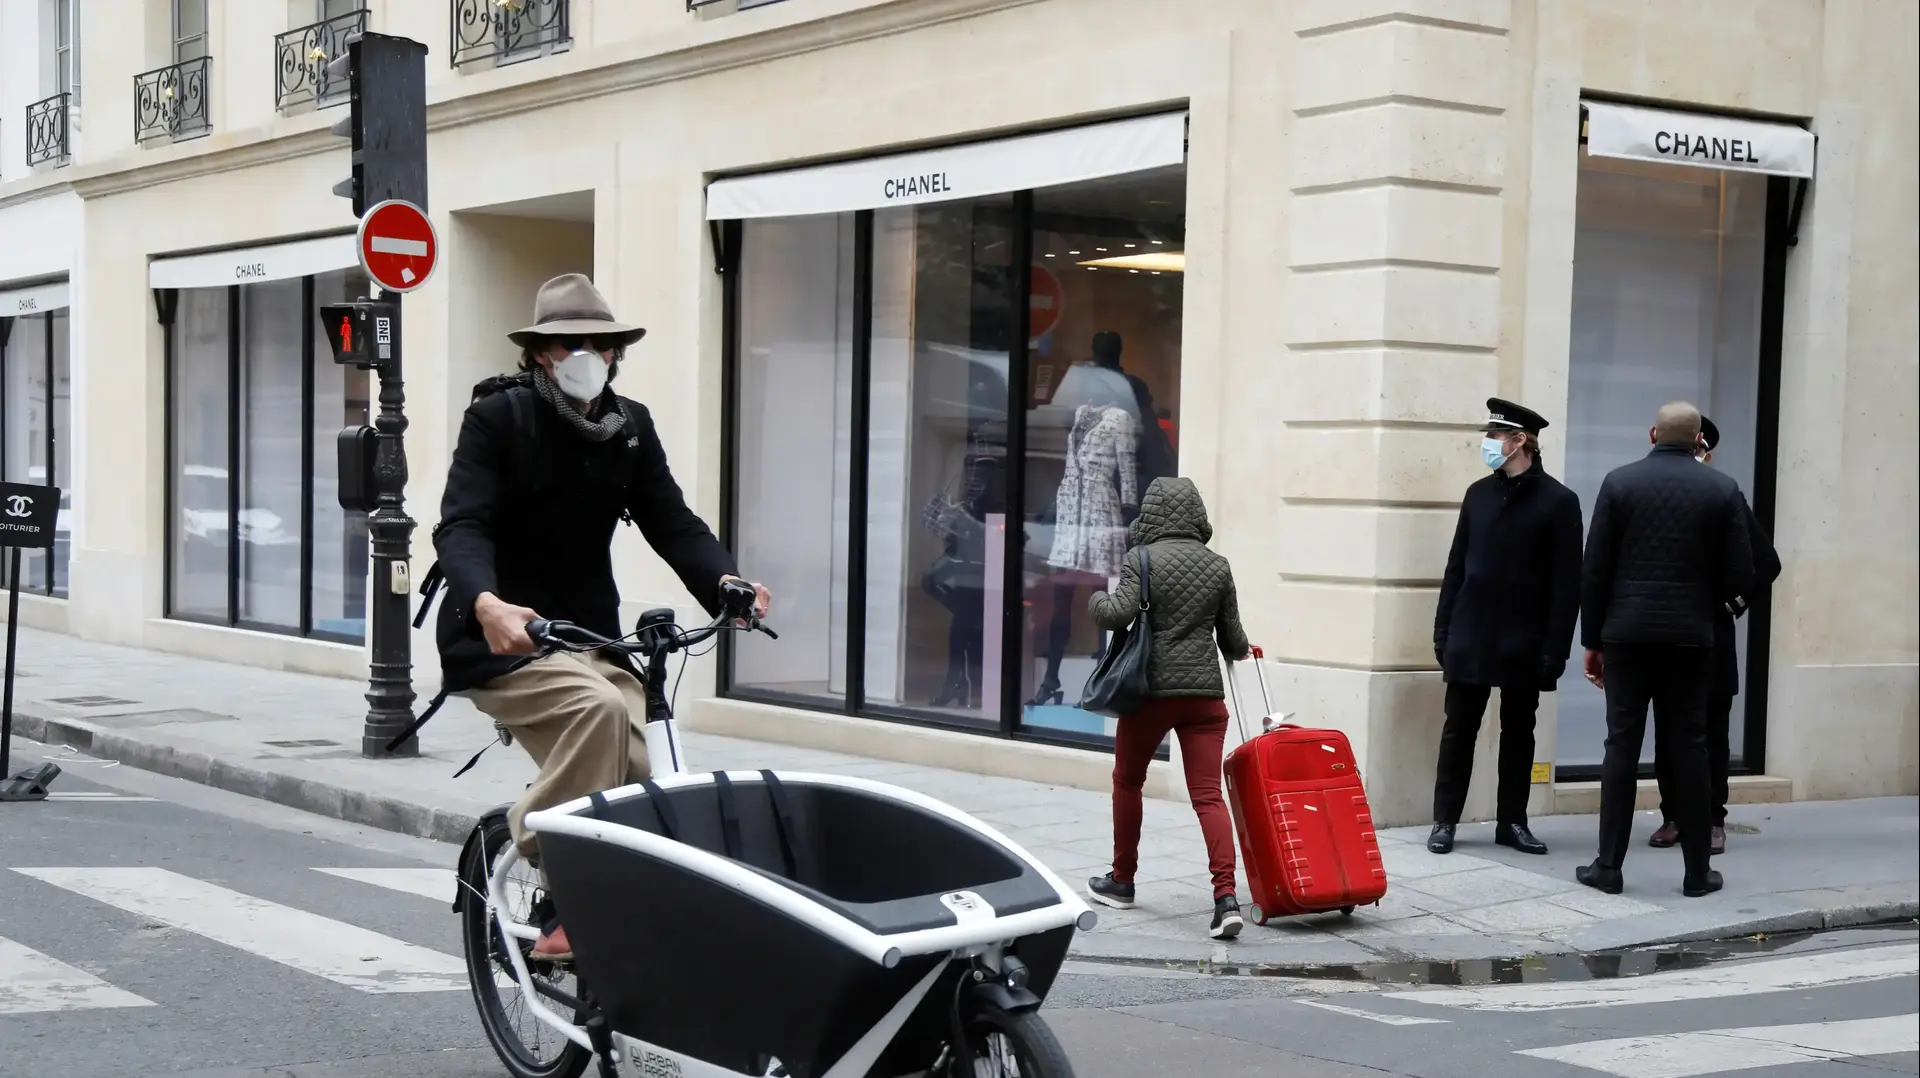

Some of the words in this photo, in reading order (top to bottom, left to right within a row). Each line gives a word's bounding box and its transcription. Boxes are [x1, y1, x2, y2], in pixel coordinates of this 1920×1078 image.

[1655, 131, 1759, 163] CHANEL
[884, 172, 951, 199] CHANEL
[235, 262, 266, 279] CHANEL
[378, 319, 389, 342] BNE
[638, 1049, 682, 1074] URBAN
